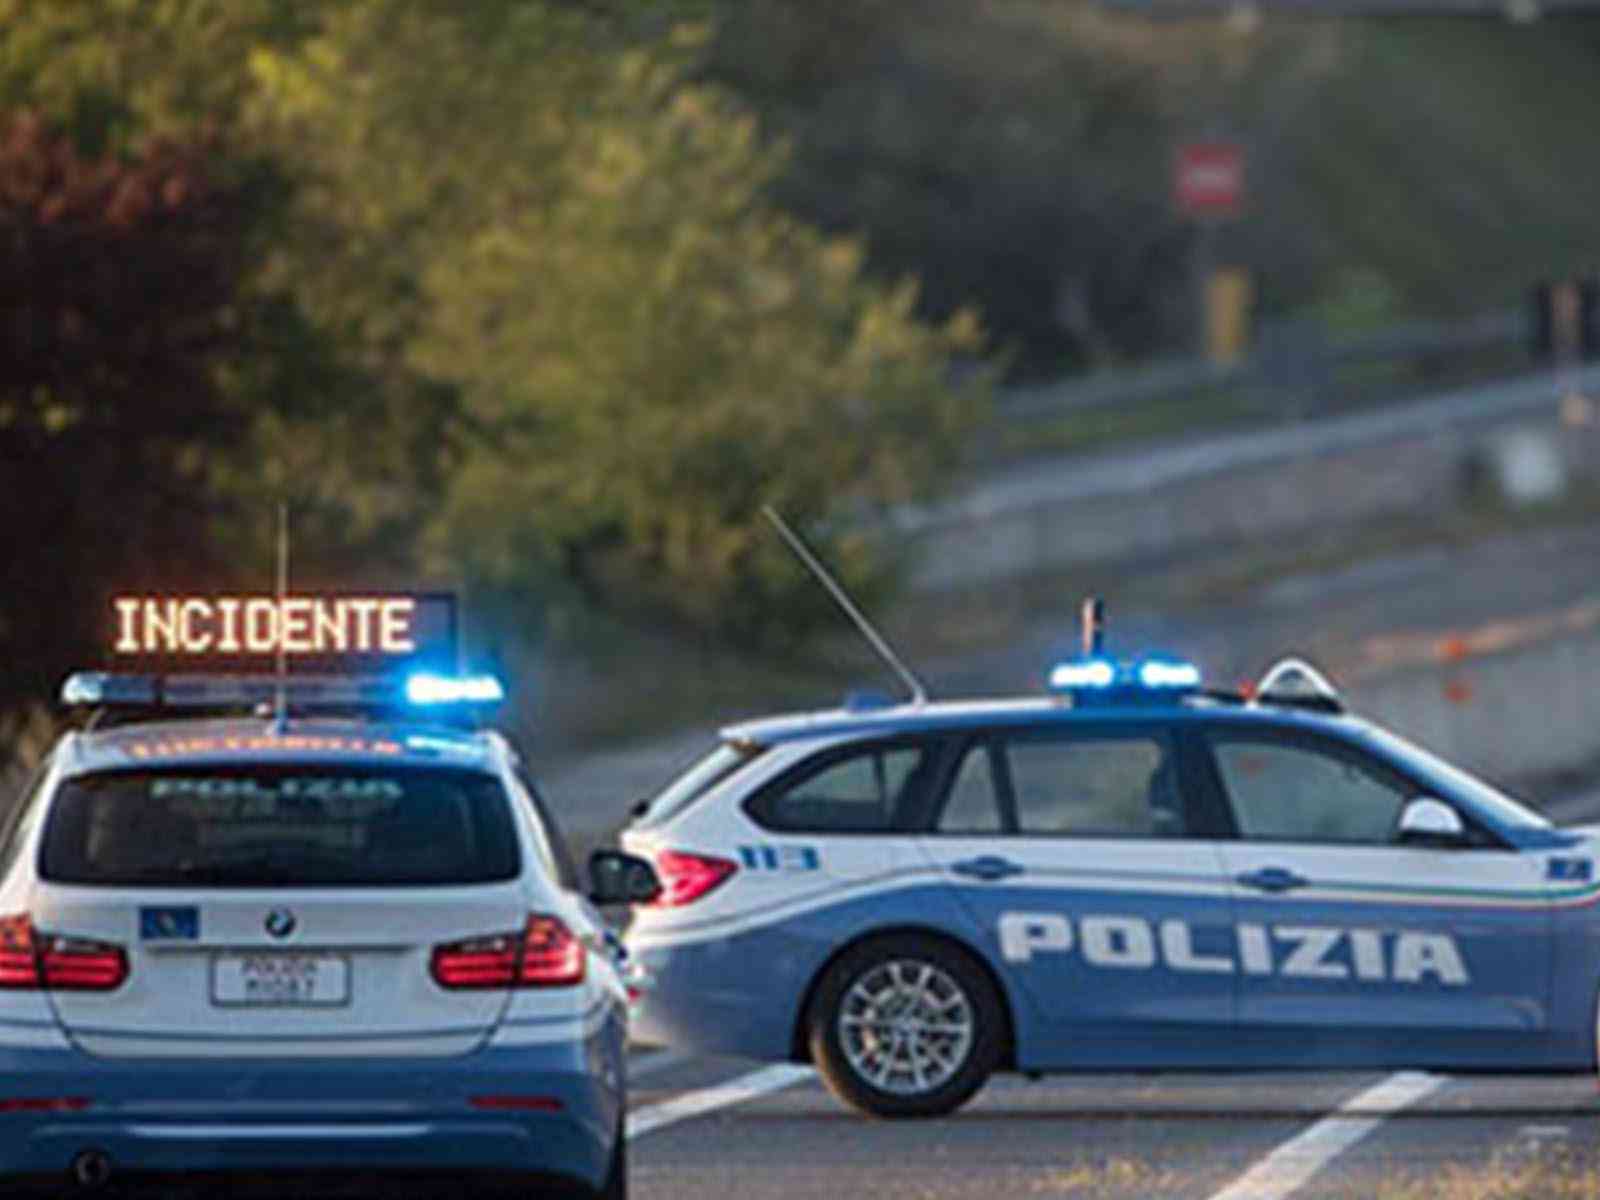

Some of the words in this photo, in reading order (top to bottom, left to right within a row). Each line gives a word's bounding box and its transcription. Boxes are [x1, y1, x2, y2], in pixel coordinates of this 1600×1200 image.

[114, 598, 415, 653] INCIDENTE
[736, 845, 821, 871] 113
[998, 911, 1469, 986] POLIZIA
